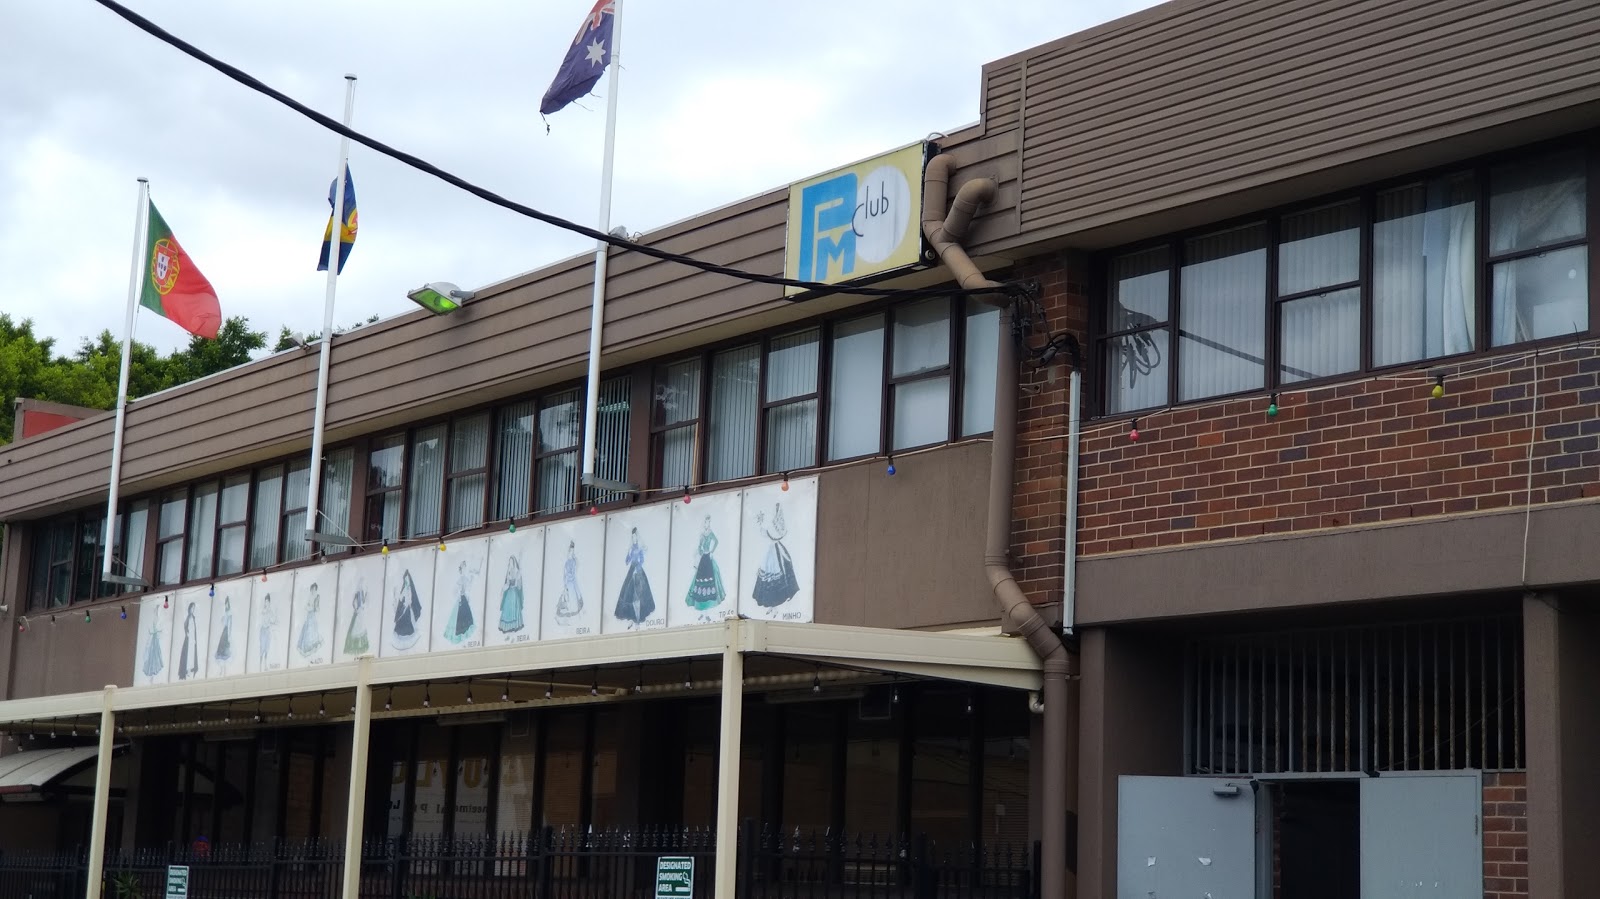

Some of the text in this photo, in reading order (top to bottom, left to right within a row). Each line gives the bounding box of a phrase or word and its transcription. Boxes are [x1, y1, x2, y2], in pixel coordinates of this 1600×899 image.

[782, 611, 802, 620] MINHO
[645, 618, 665, 627] DOURO
[576, 627, 591, 635] BEIRA
[467, 640, 481, 648] BEIRA
[660, 861, 691, 869] DESIGNATED
[659, 873, 683, 881] SMOKING
[659, 884, 672, 892] AREA
